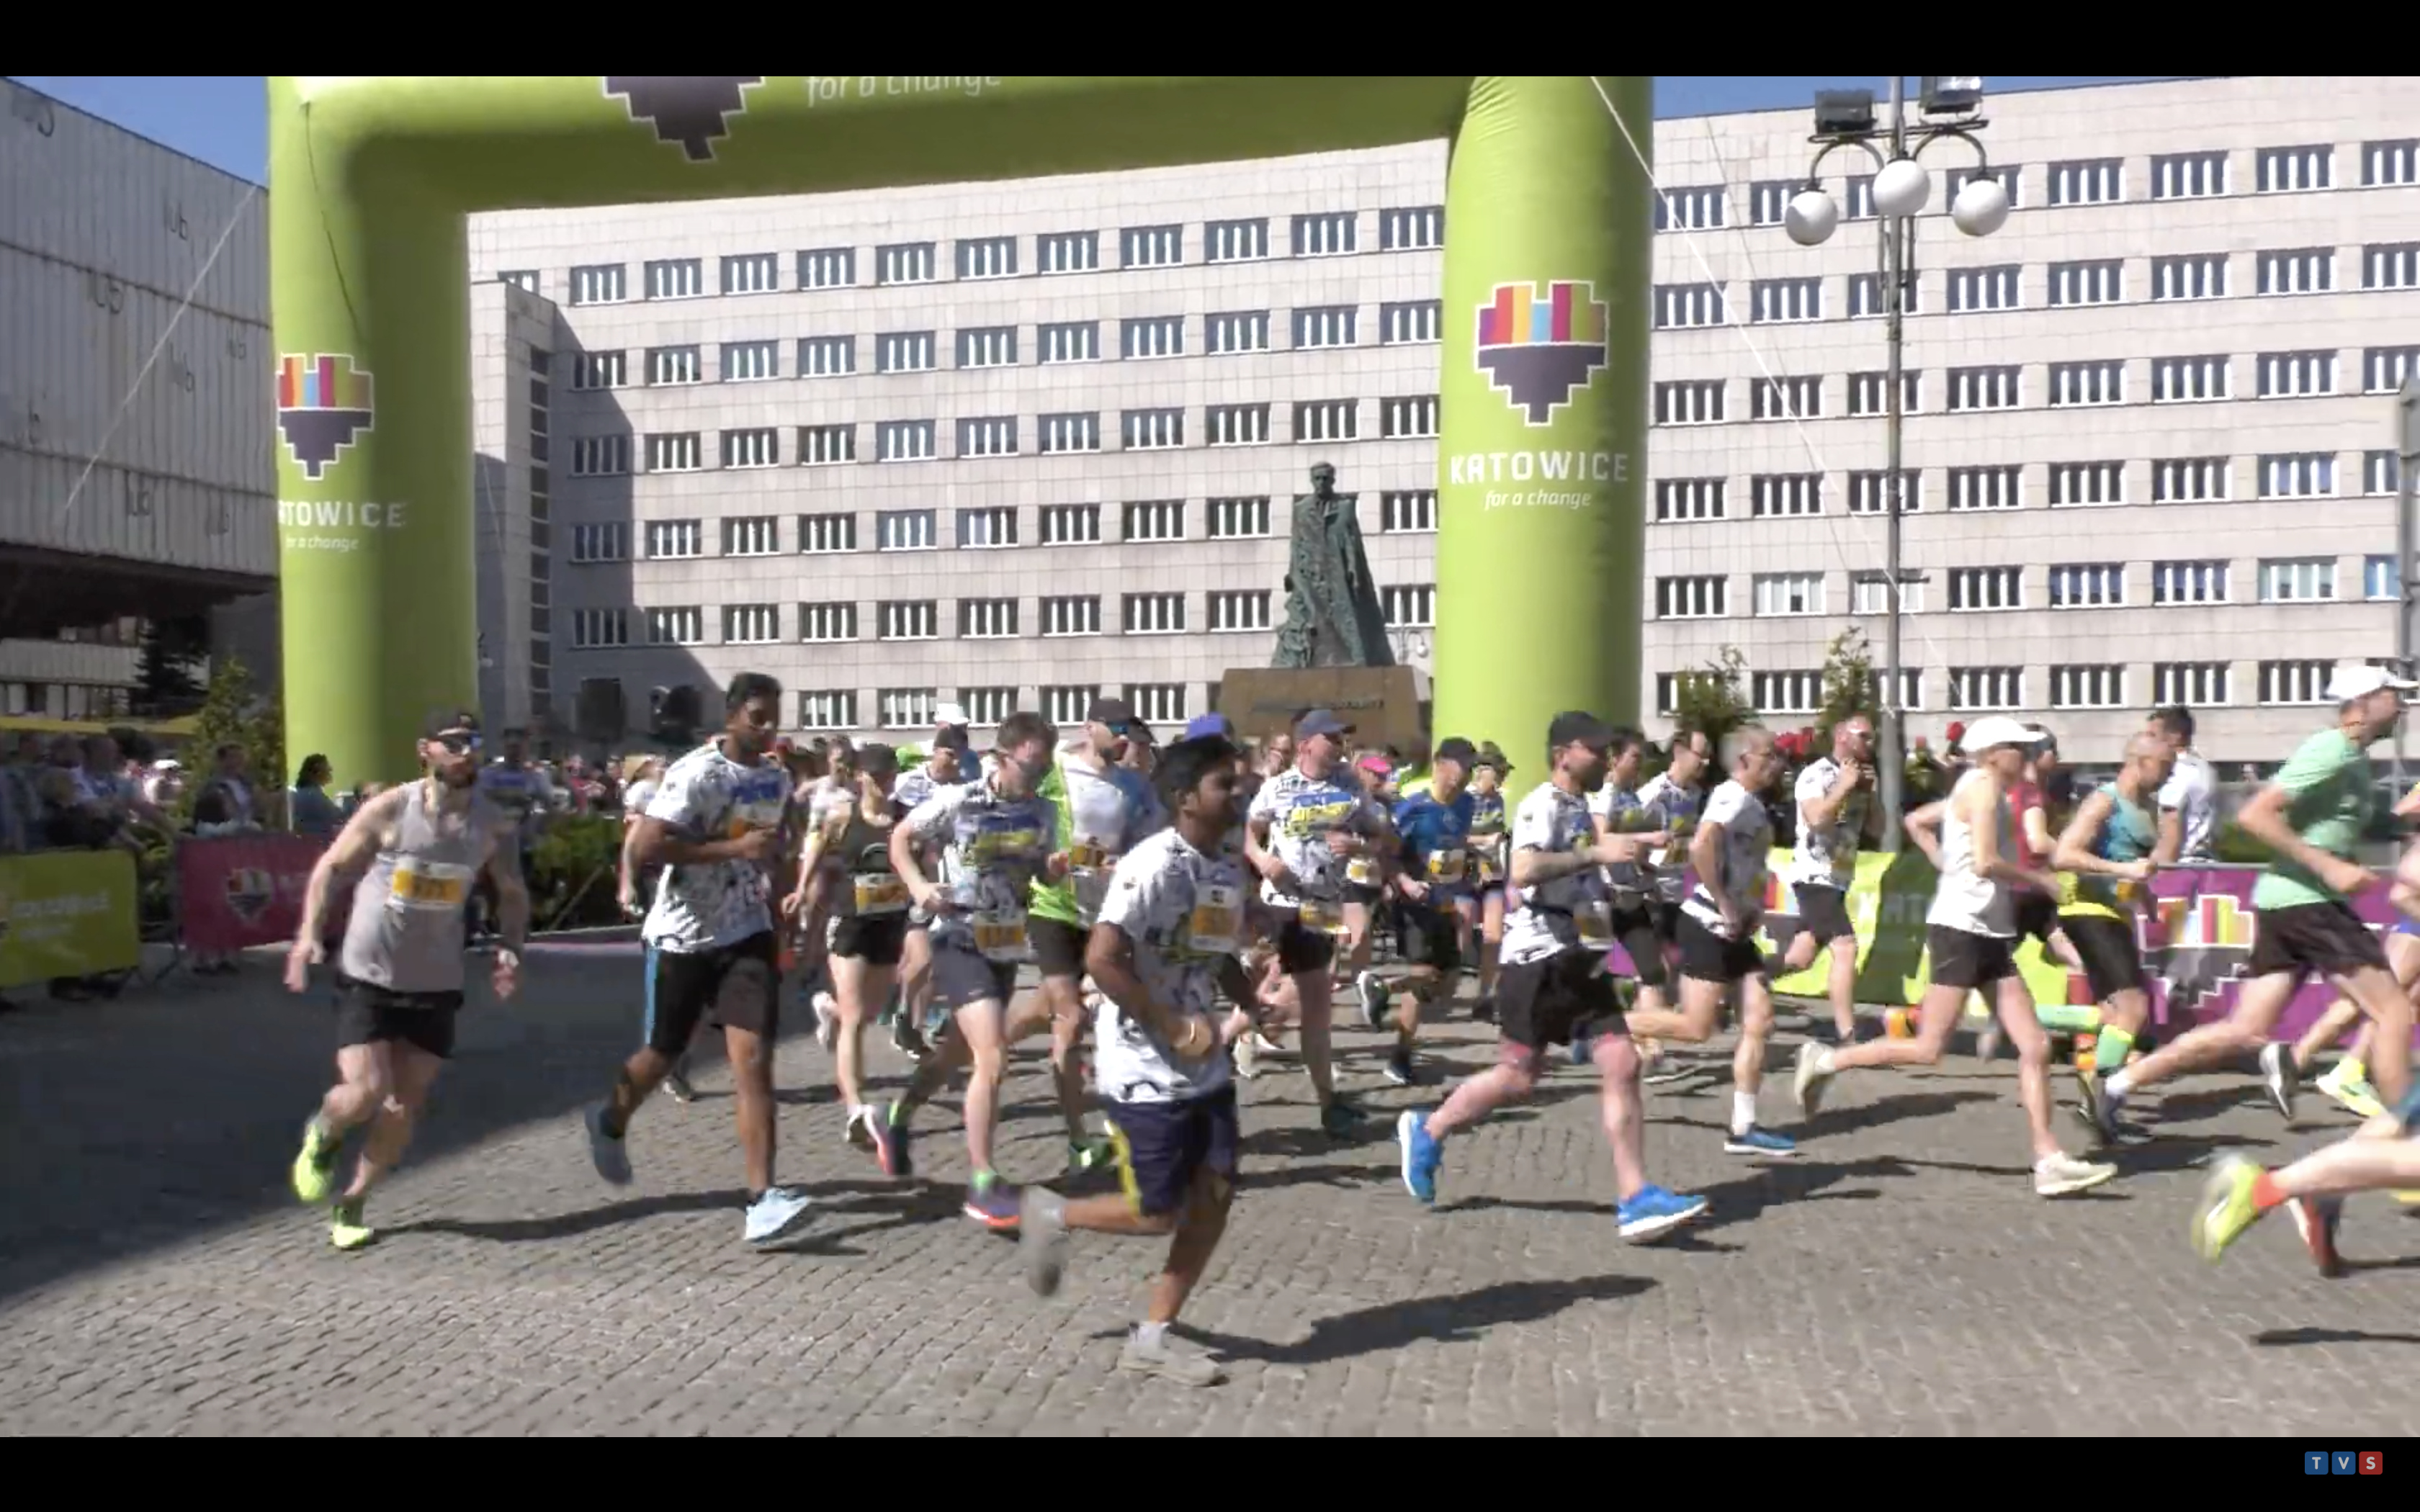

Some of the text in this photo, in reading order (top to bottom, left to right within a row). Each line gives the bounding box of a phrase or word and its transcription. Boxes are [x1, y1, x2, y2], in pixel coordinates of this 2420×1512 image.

[1451, 451, 1628, 485] KATOWICE
[1484, 489, 1592, 510] for a change
